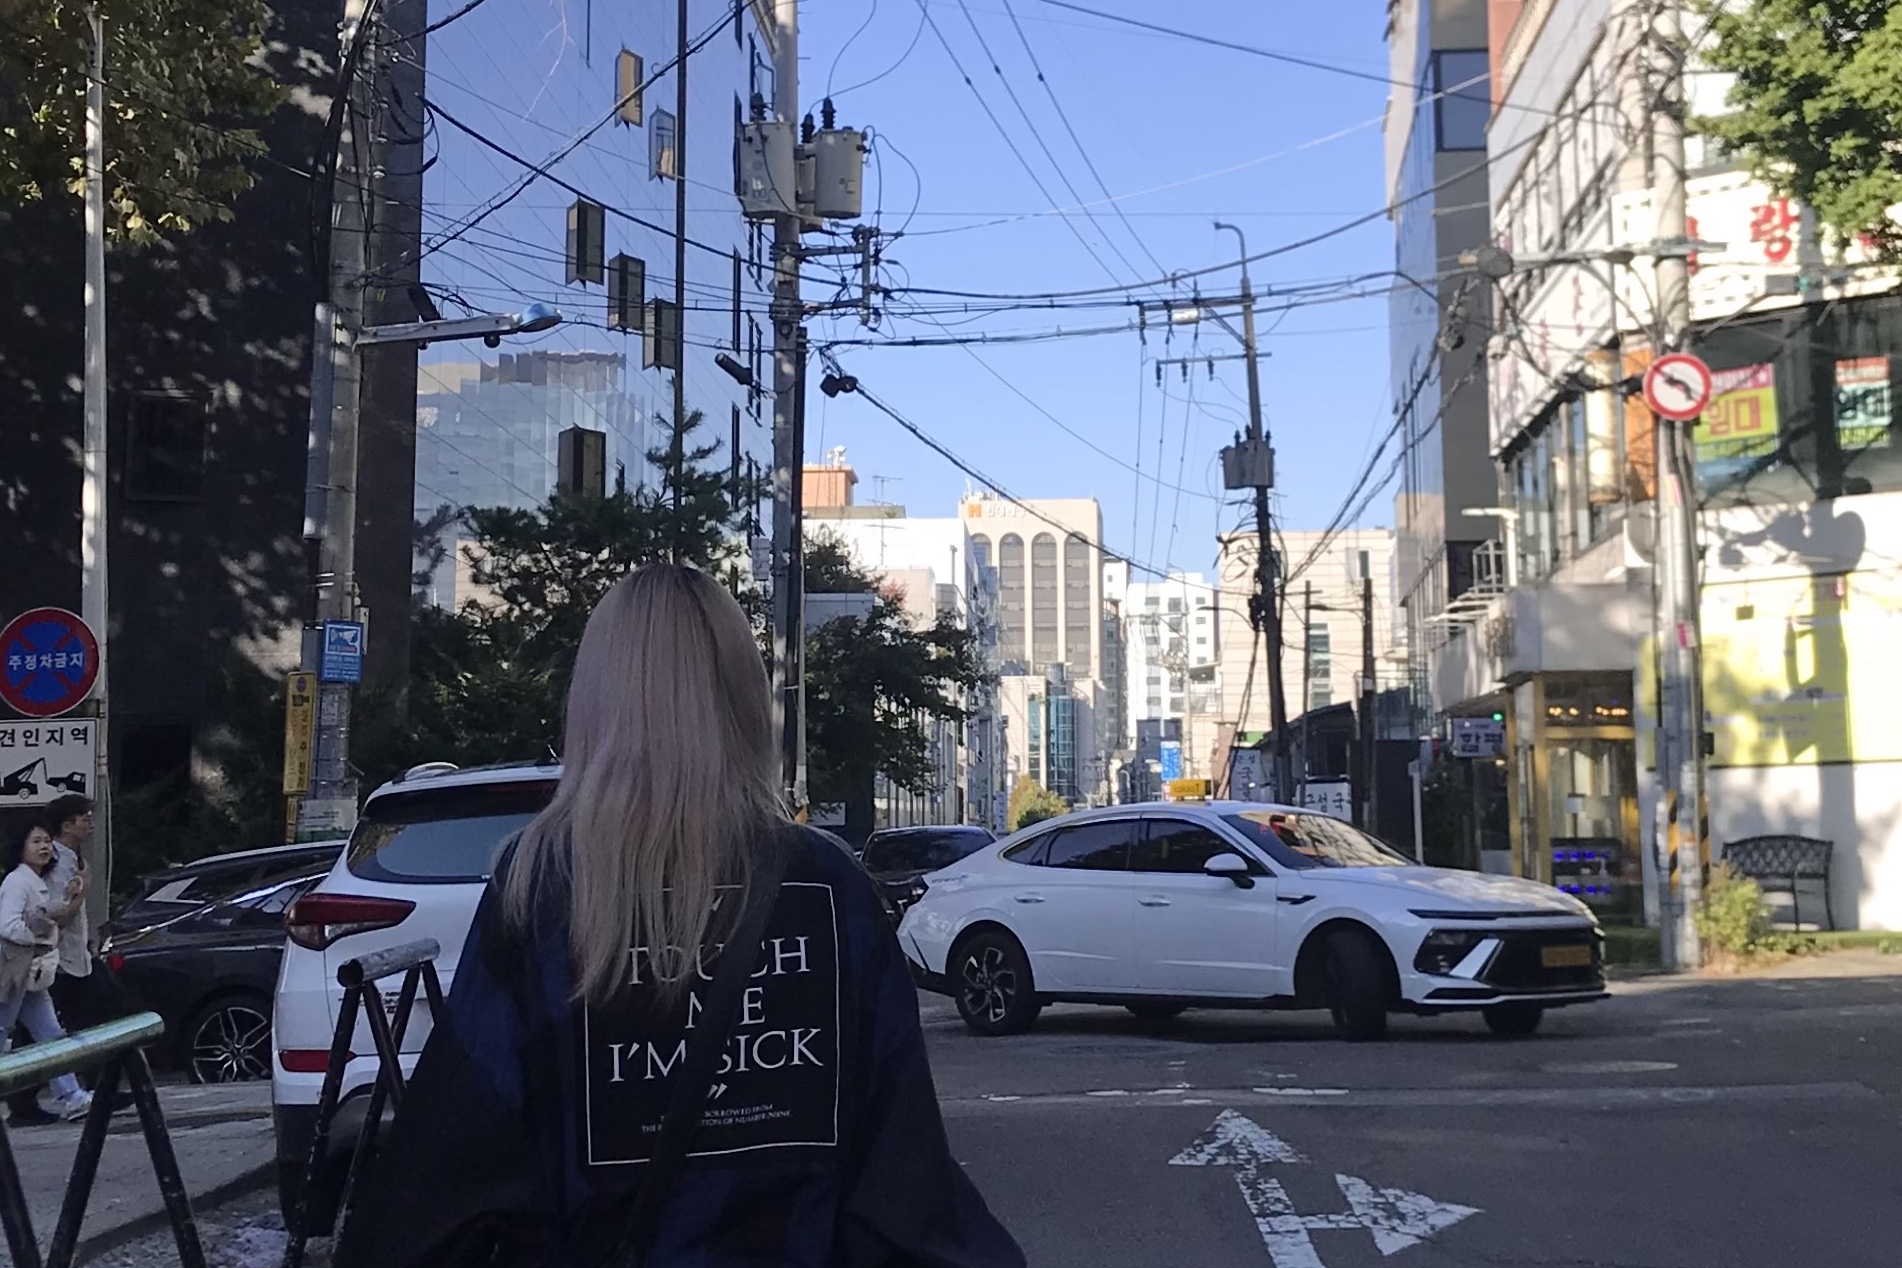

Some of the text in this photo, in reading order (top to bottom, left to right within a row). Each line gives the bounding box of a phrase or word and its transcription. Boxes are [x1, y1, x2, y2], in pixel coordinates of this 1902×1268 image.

[8, 652, 84, 671] 주정차금지
[0, 726, 89, 747] 견인지역
[628, 936, 810, 985] TOUH
[608, 1038, 687, 1082] I'M
